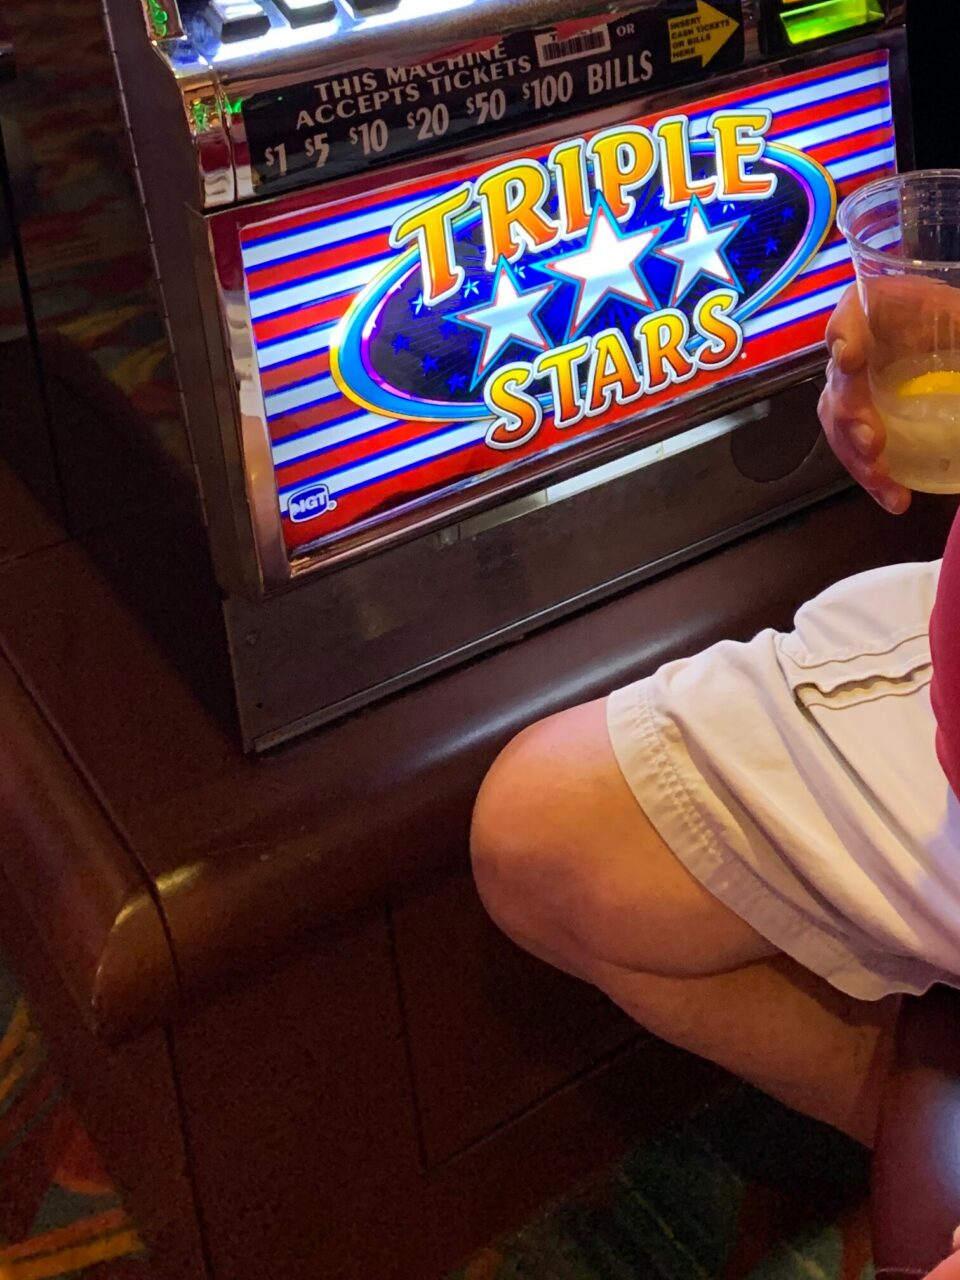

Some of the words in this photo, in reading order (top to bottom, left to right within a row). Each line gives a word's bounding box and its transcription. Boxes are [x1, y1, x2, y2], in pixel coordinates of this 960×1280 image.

[616, 23, 635, 37] OR
[670, 17, 701, 30] INSERT
[671, 28, 694, 40] CASH
[696, 19, 730, 34] TICKETS
[672, 39, 684, 49] OR
[687, 33, 711, 46] BILLS
[314, 72, 377, 102] THIS
[386, 40, 507, 86] MACHINE
[673, 47, 695, 58] HERE
[264, 143, 288, 176] $1
[305, 132, 330, 168] $5
[349, 119, 389, 156] $10
[406, 103, 450, 141] $20
[466, 88, 506, 125] $50
[522, 71, 574, 110] $100
[587, 50, 653, 96] BILLS
[296, 83, 420, 130] ACCEPTS
[428, 55, 532, 96] TICKETS
[388, 107, 778, 307] TRIPLE
[484, 289, 743, 450] STARS
